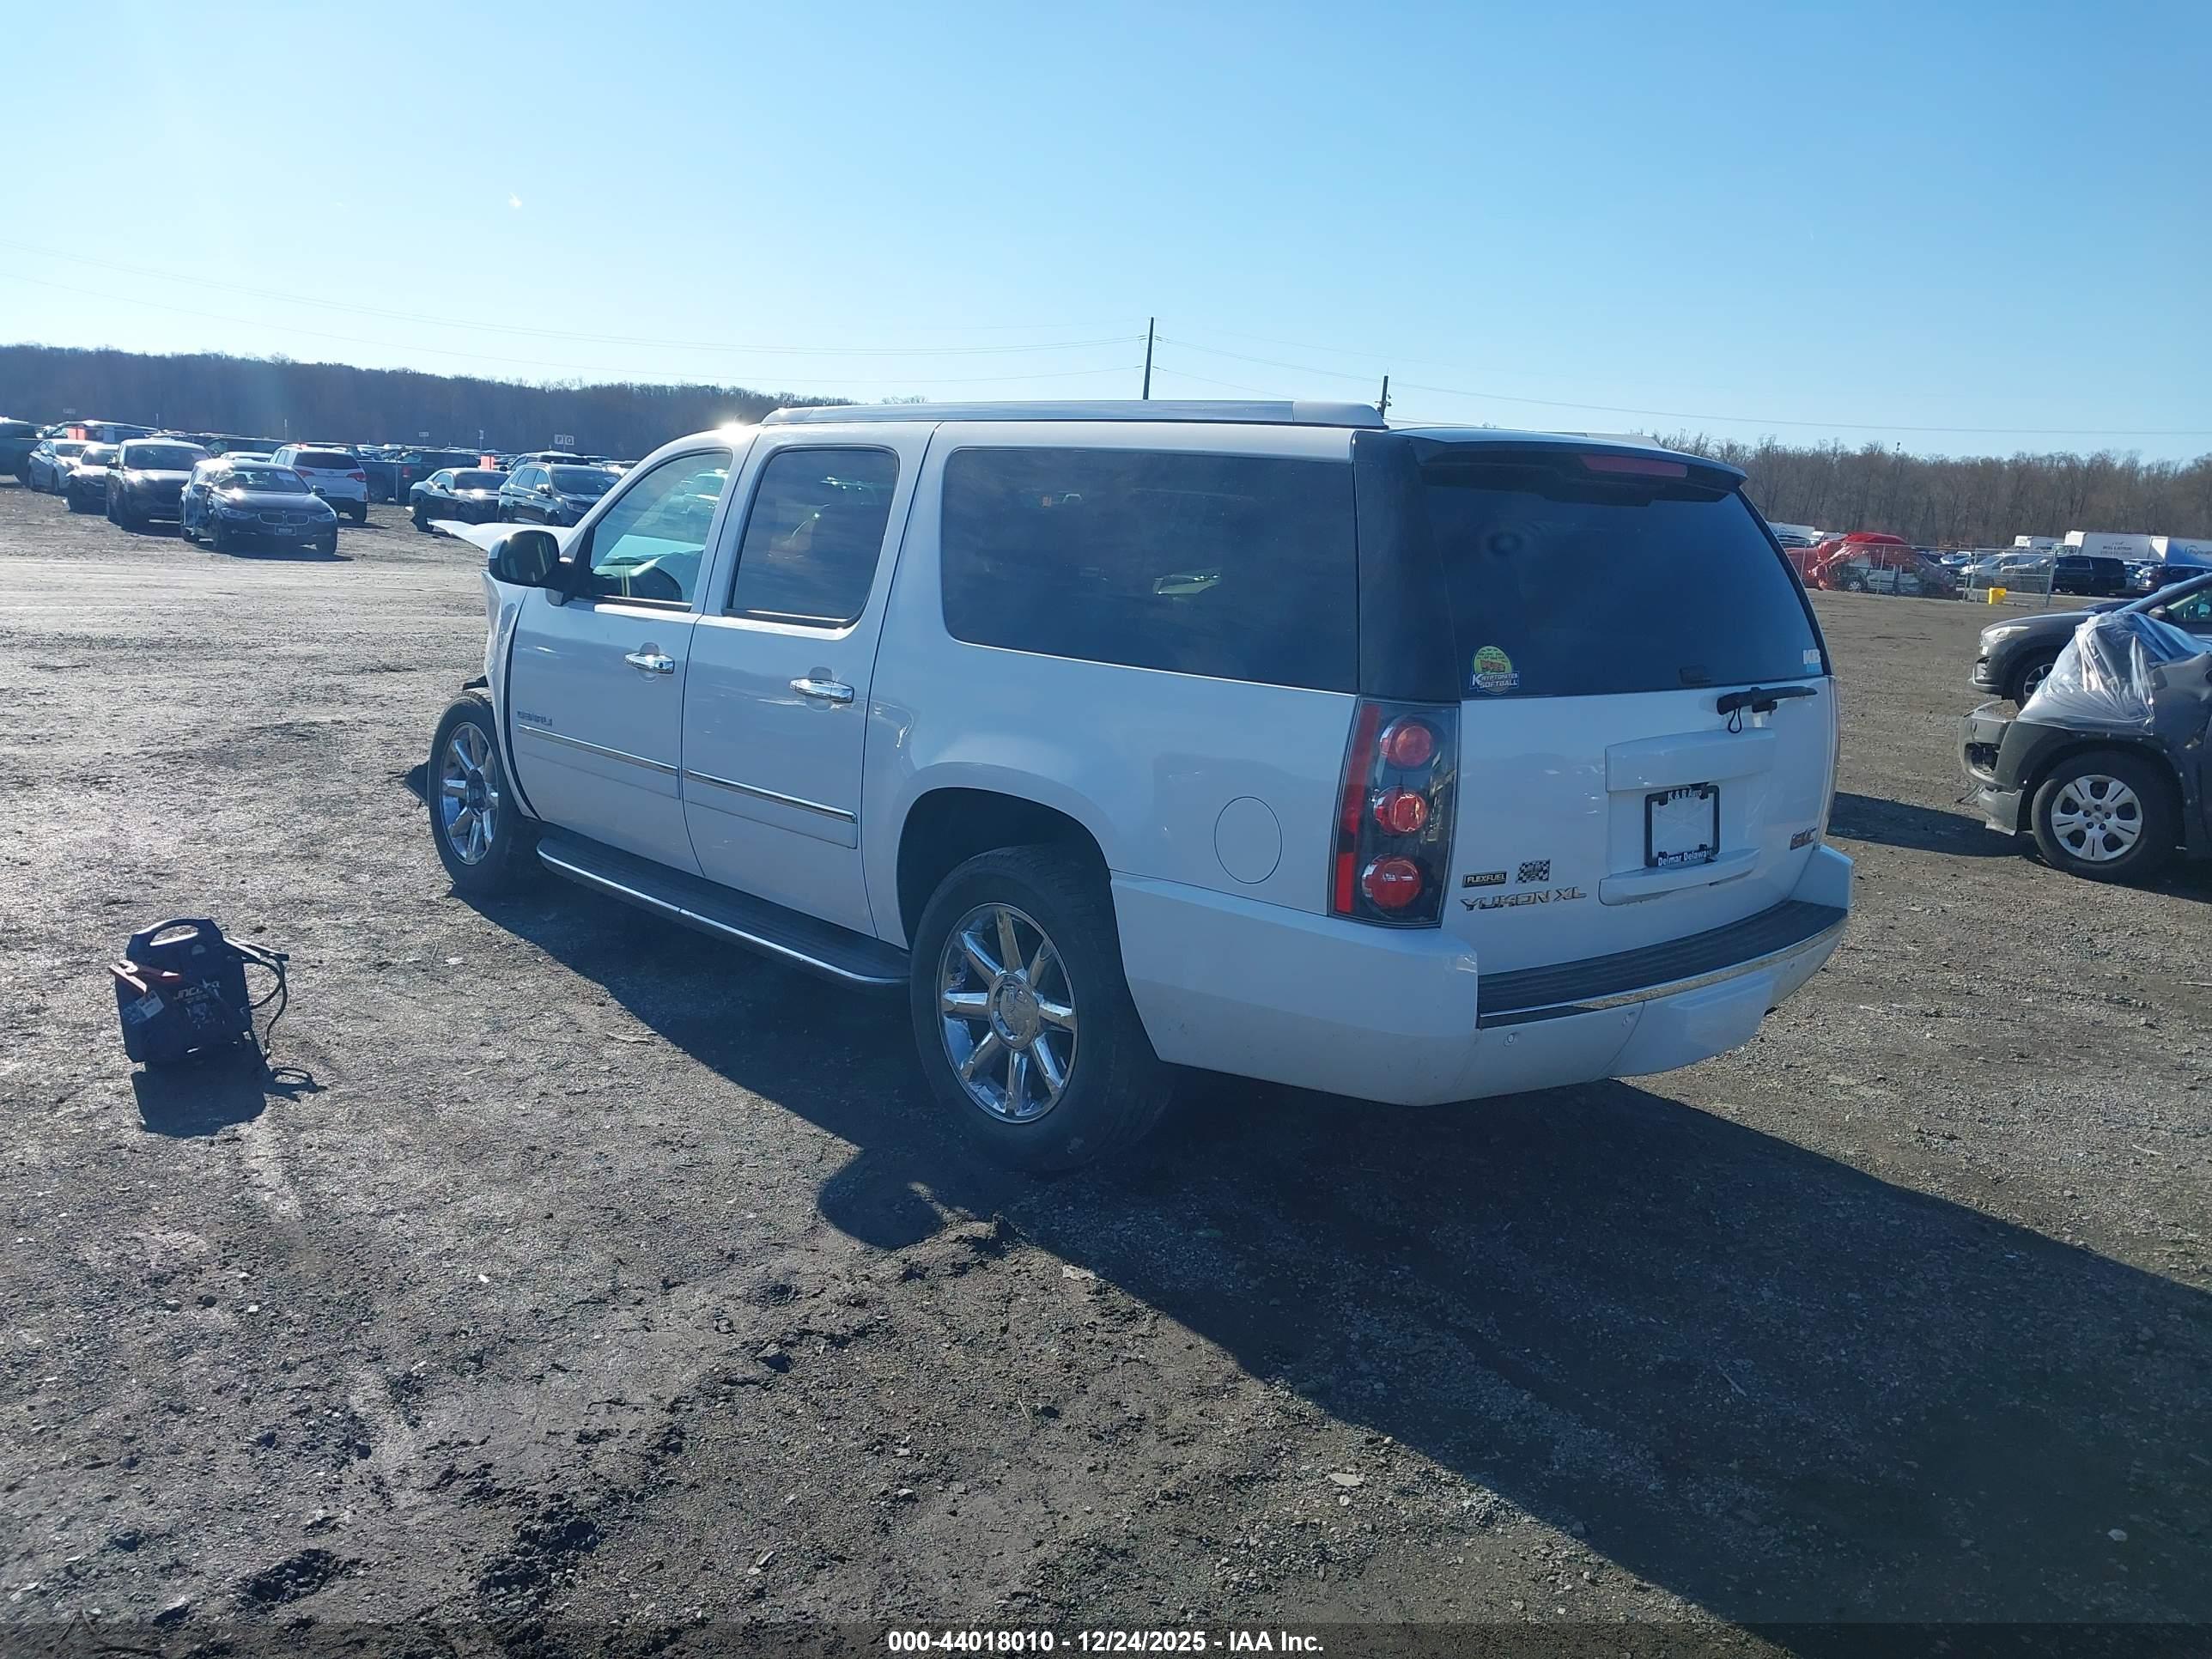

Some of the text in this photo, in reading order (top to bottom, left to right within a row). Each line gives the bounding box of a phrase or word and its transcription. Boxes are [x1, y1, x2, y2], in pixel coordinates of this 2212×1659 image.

[1479, 679, 1518, 689] SOFTBALL
[1688, 788, 1703, 798] Auto
[1657, 854, 1682, 866] Delmar
[1467, 873, 1505, 884] FLEXFUEL
[1461, 886, 1587, 911] YUKON XL
